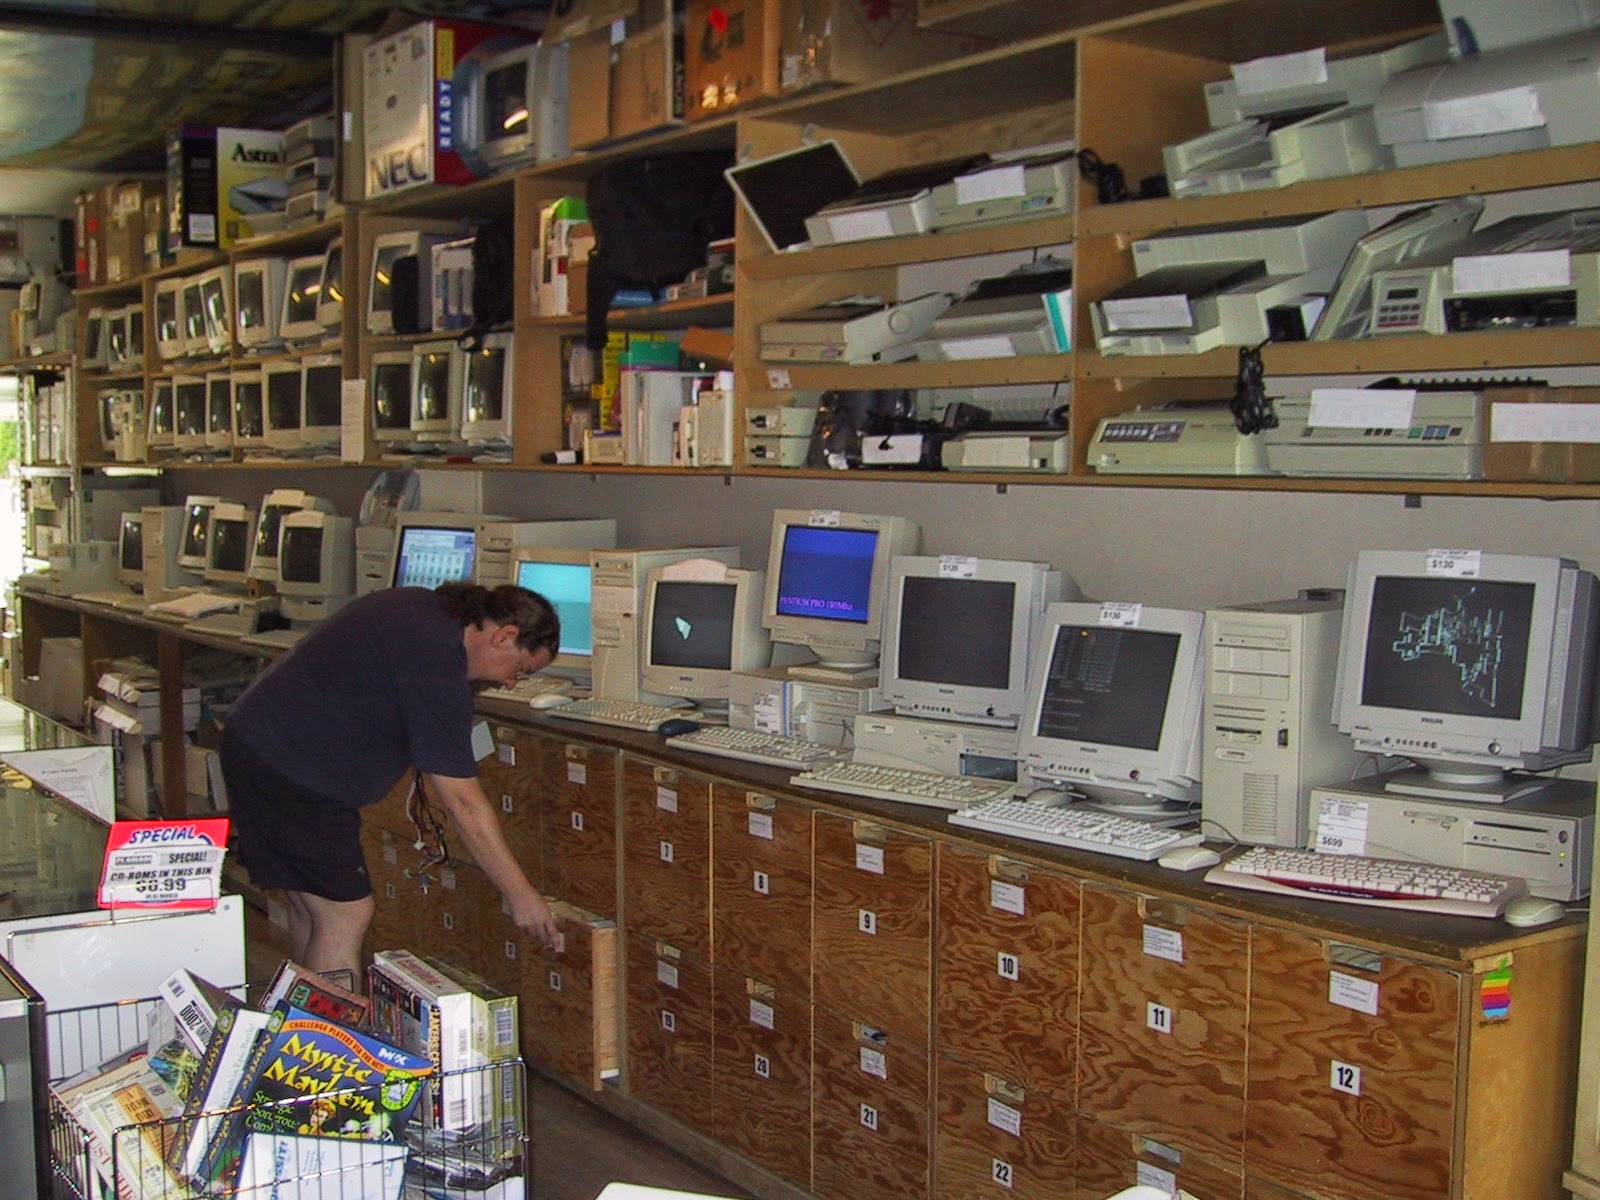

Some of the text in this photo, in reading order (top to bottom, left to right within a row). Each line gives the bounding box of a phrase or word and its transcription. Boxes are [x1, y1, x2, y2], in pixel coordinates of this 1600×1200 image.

[369, 142, 427, 193] NEC
[128, 826, 195, 844] SPECIAL
[169, 851, 207, 864] SPECIAL!
[110, 866, 213, 881] CD-ROMS IN THIS BIN
[864, 913, 871, 929] 9
[1001, 957, 1014, 975] 10
[179, 1003, 201, 1032] 2000
[1153, 1008, 1165, 1027] 11
[289, 1021, 328, 1032] CHALLENGE
[329, 1026, 354, 1048] PLAYERS
[279, 1032, 373, 1083] Mystic
[757, 1058, 767, 1074] 20
[1337, 1066, 1354, 1089] 12
[864, 1108, 874, 1125] 21
[996, 1163, 1009, 1183] 22
